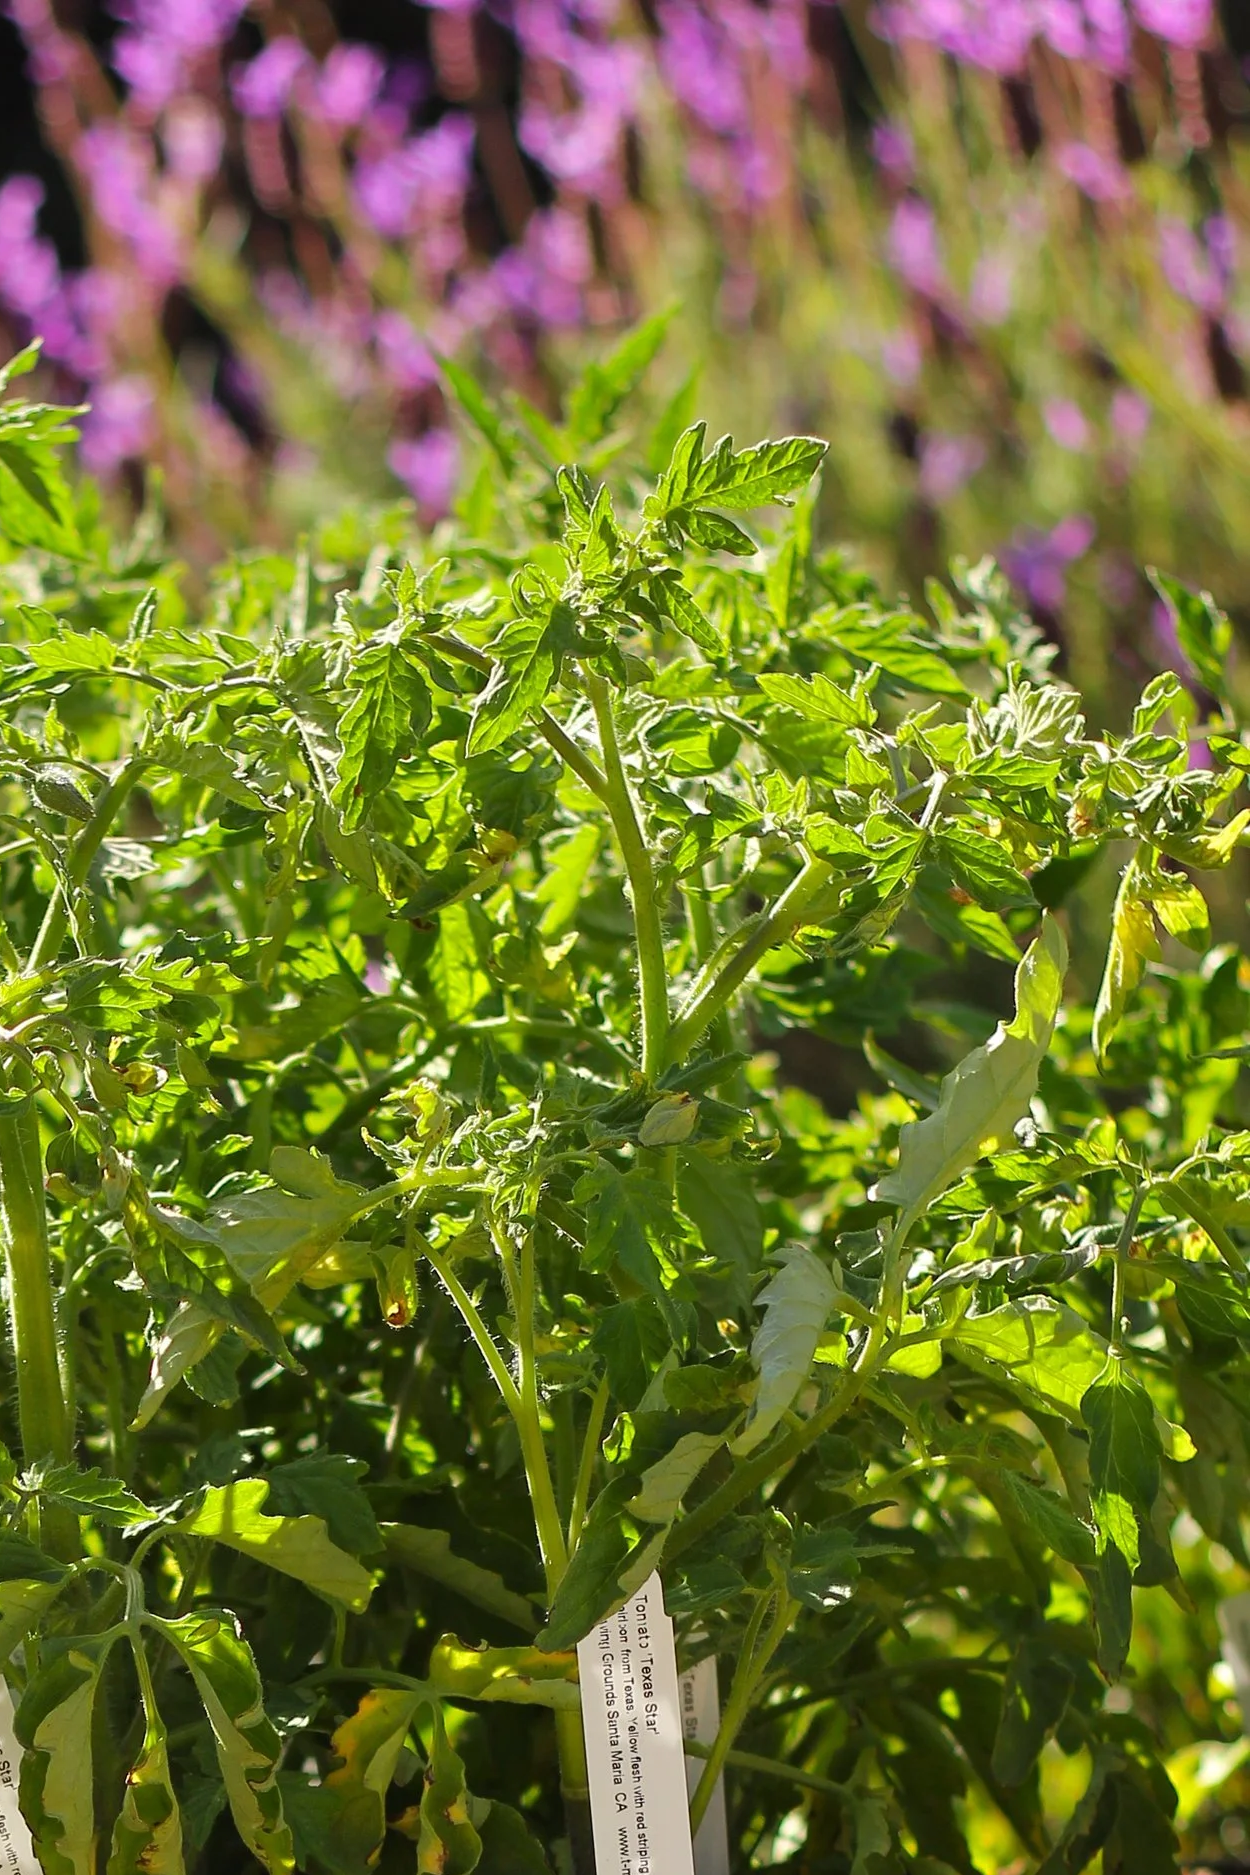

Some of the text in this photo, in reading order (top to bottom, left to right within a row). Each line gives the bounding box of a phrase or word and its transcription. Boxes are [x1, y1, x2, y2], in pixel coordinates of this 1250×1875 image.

[621, 1649, 632, 1674] from
[635, 1594, 660, 1735] Tomato 'Texas Star'
[602, 1653, 618, 1707] Grounds
[607, 1711, 621, 1746] Santa
[628, 1717, 639, 1754] Yellow
[610, 1750, 625, 1785] Maria
[631, 1756, 642, 1783] flesh
[615, 1792, 628, 1813] CA
[634, 1785, 645, 1809] with
[636, 1811, 647, 1830] red
[4, 1843, 18, 1866] with
